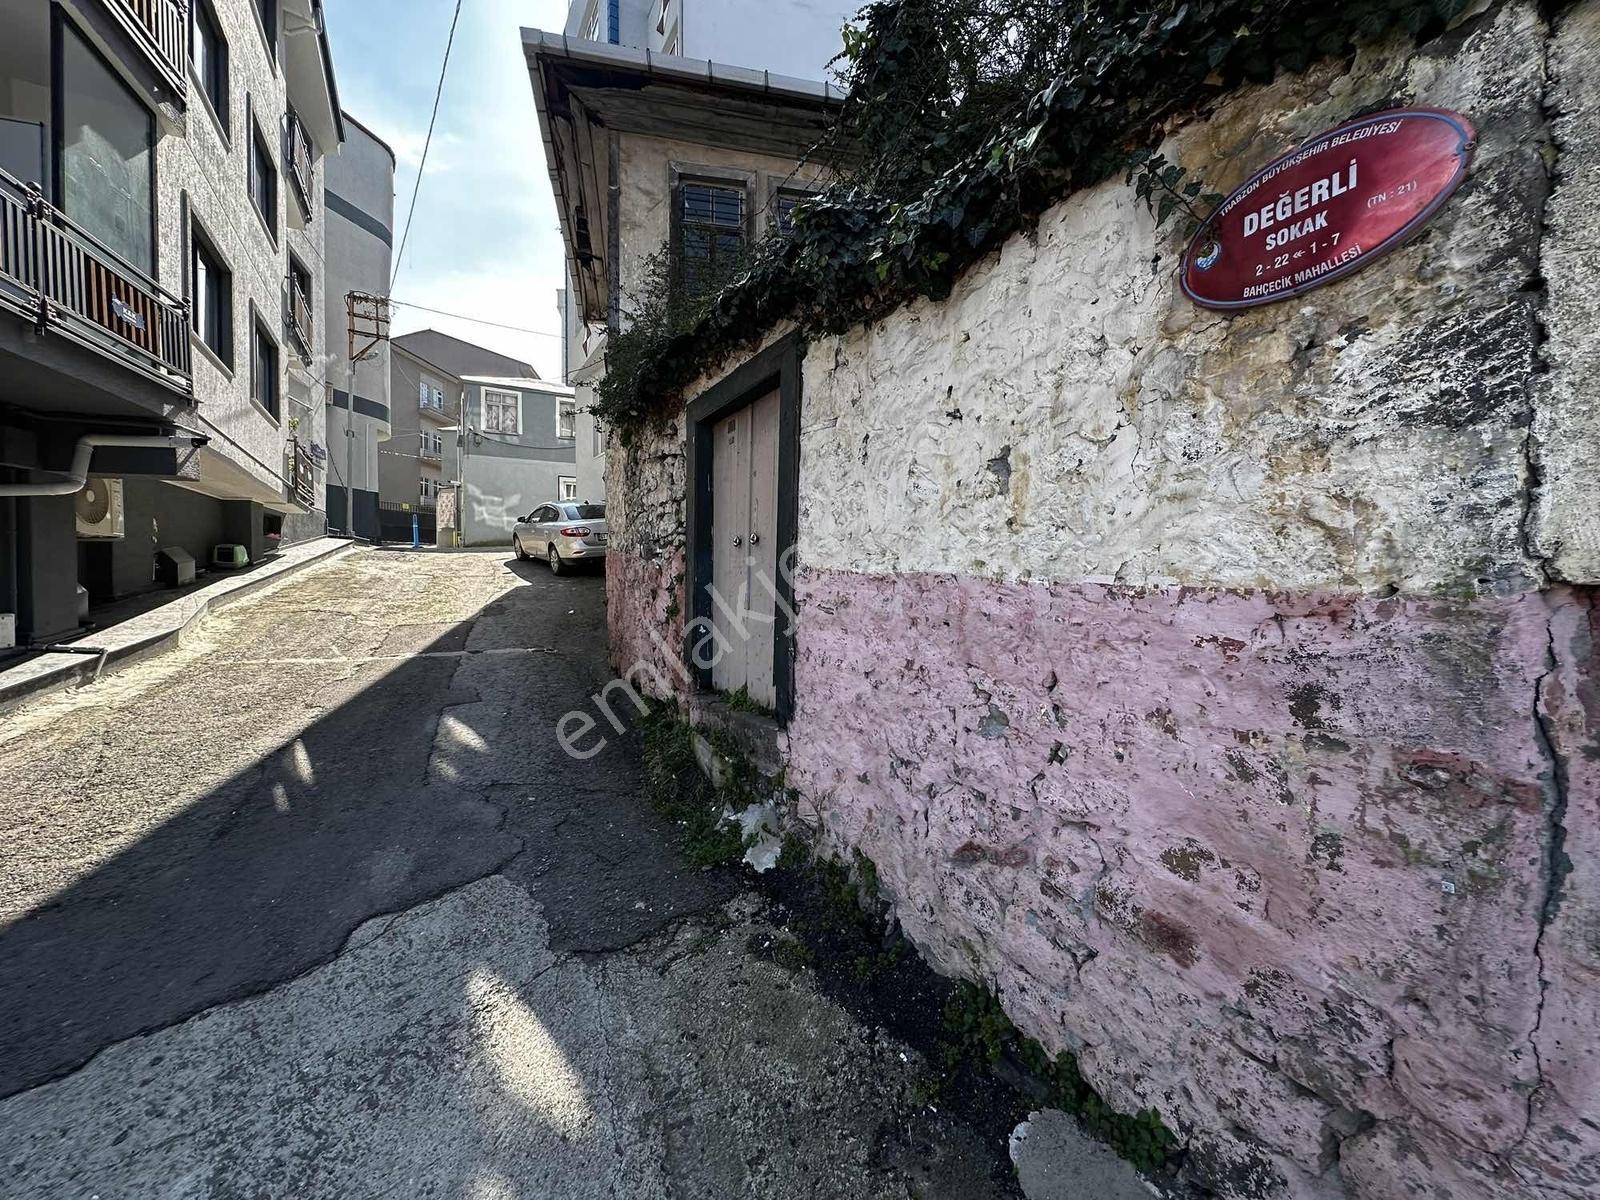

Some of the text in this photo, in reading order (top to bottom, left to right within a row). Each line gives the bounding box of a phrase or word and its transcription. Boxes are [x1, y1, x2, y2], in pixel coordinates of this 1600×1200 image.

[1219, 180, 1260, 217] TRABZON
[1330, 118, 1404, 148] BELEDİYESİ
[1243, 158, 1358, 238] DEĞERLİ
[1255, 264, 1264, 277] 2
[1274, 253, 1290, 269] 22
[1310, 241, 1318, 254] 1
[1331, 232, 1341, 246] 7
[1265, 209, 1329, 251] SOKAK
[1243, 242, 1362, 298] BAHÇECİK MAHALLESİ
